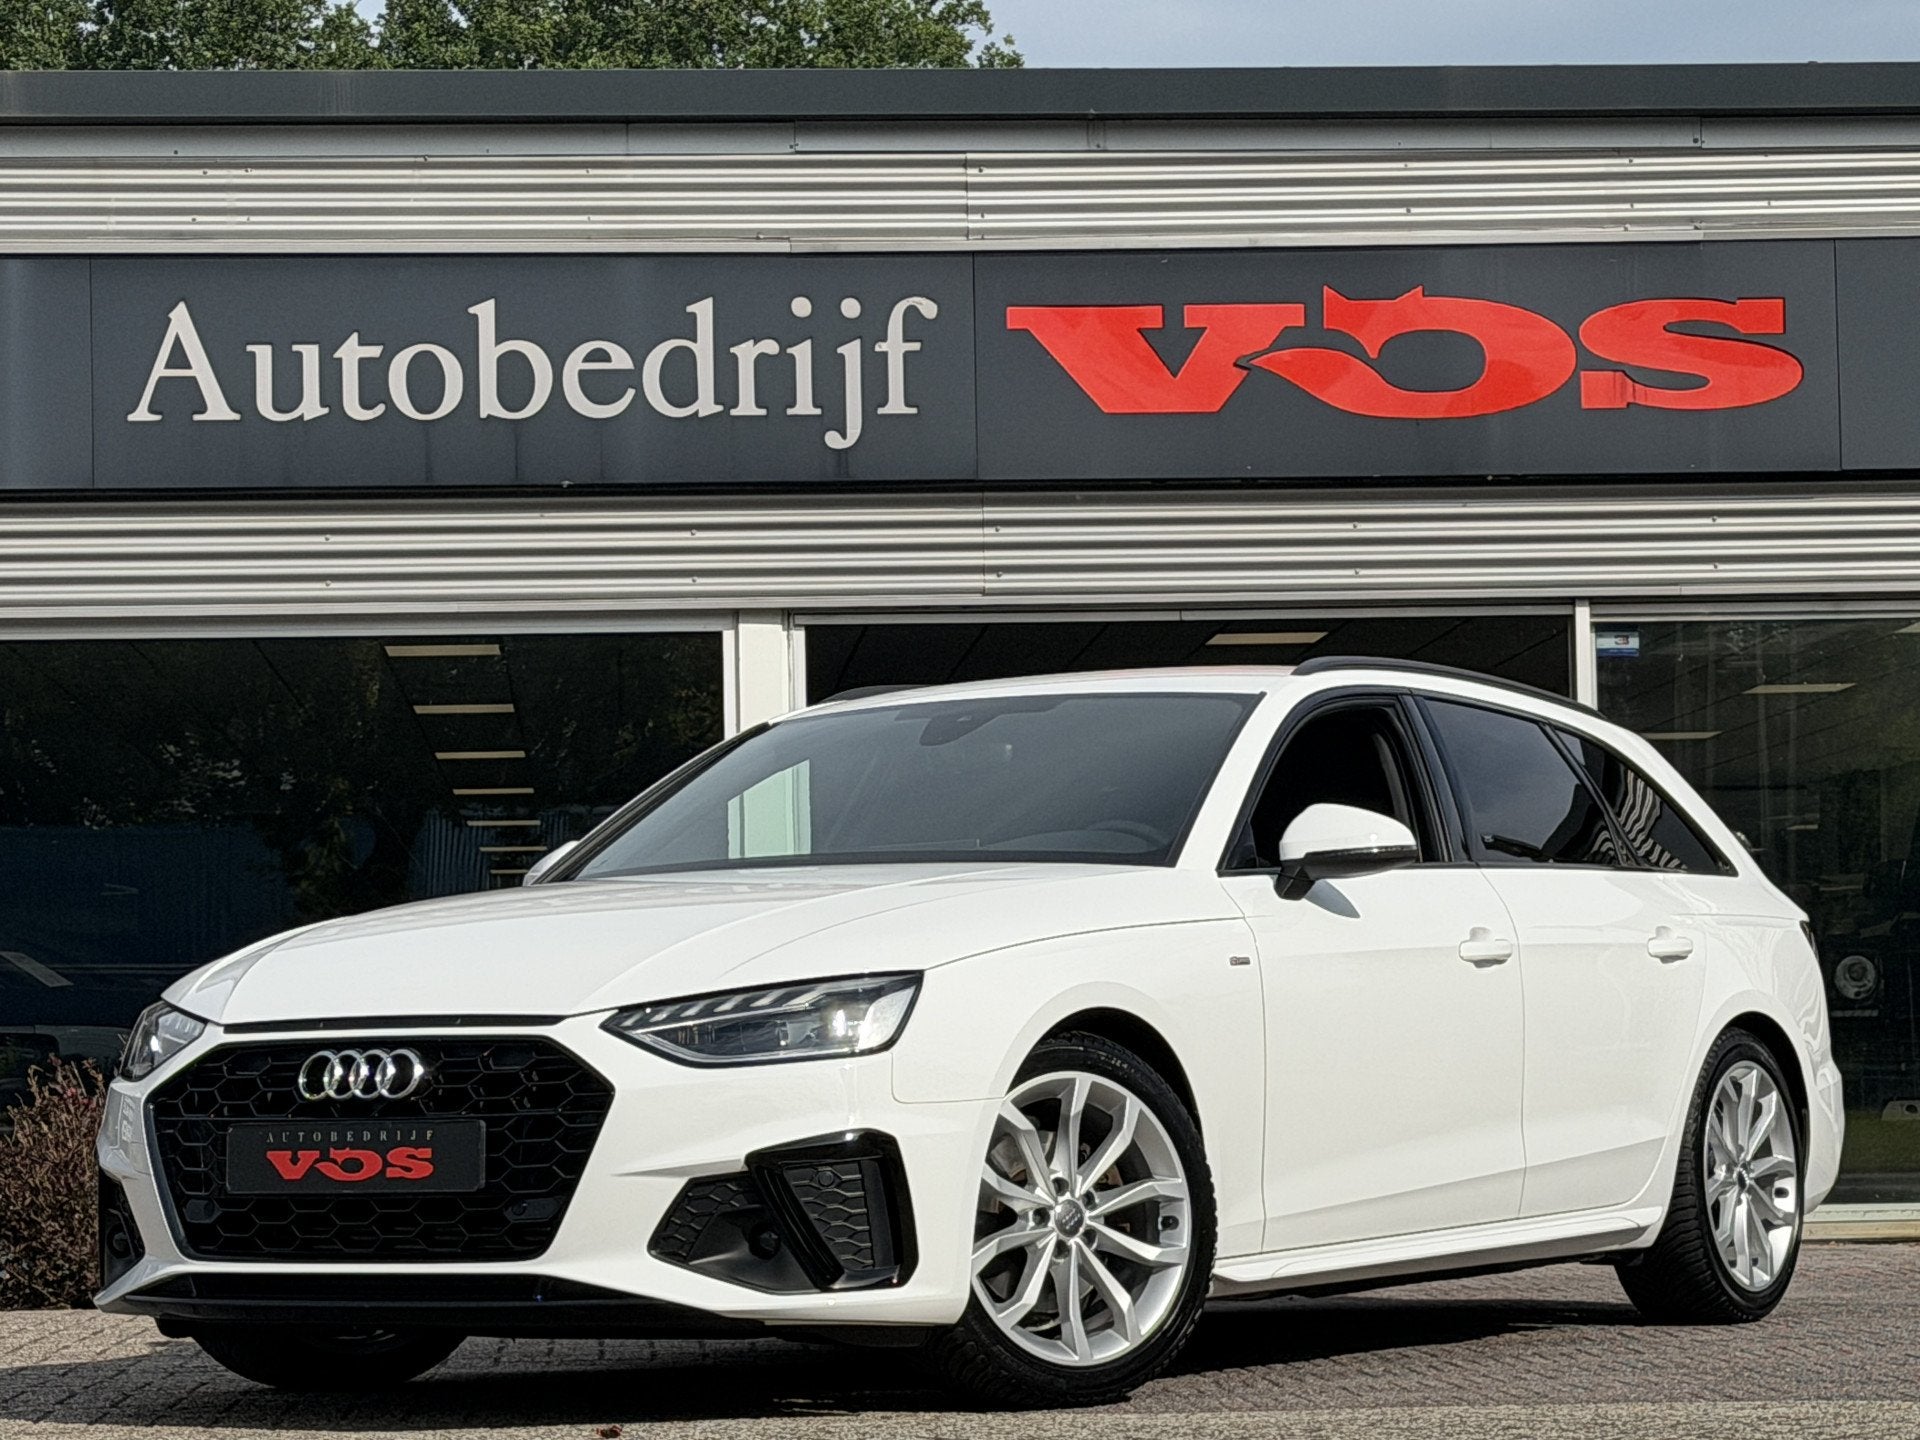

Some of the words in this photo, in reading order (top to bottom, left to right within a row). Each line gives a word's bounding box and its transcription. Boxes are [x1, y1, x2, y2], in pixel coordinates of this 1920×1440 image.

[126, 296, 939, 451] Autobedrijf
[1005, 285, 1805, 420] VOS
[266, 1130, 434, 1143] AUTOBEDRIJF
[266, 1147, 434, 1182] VOS
